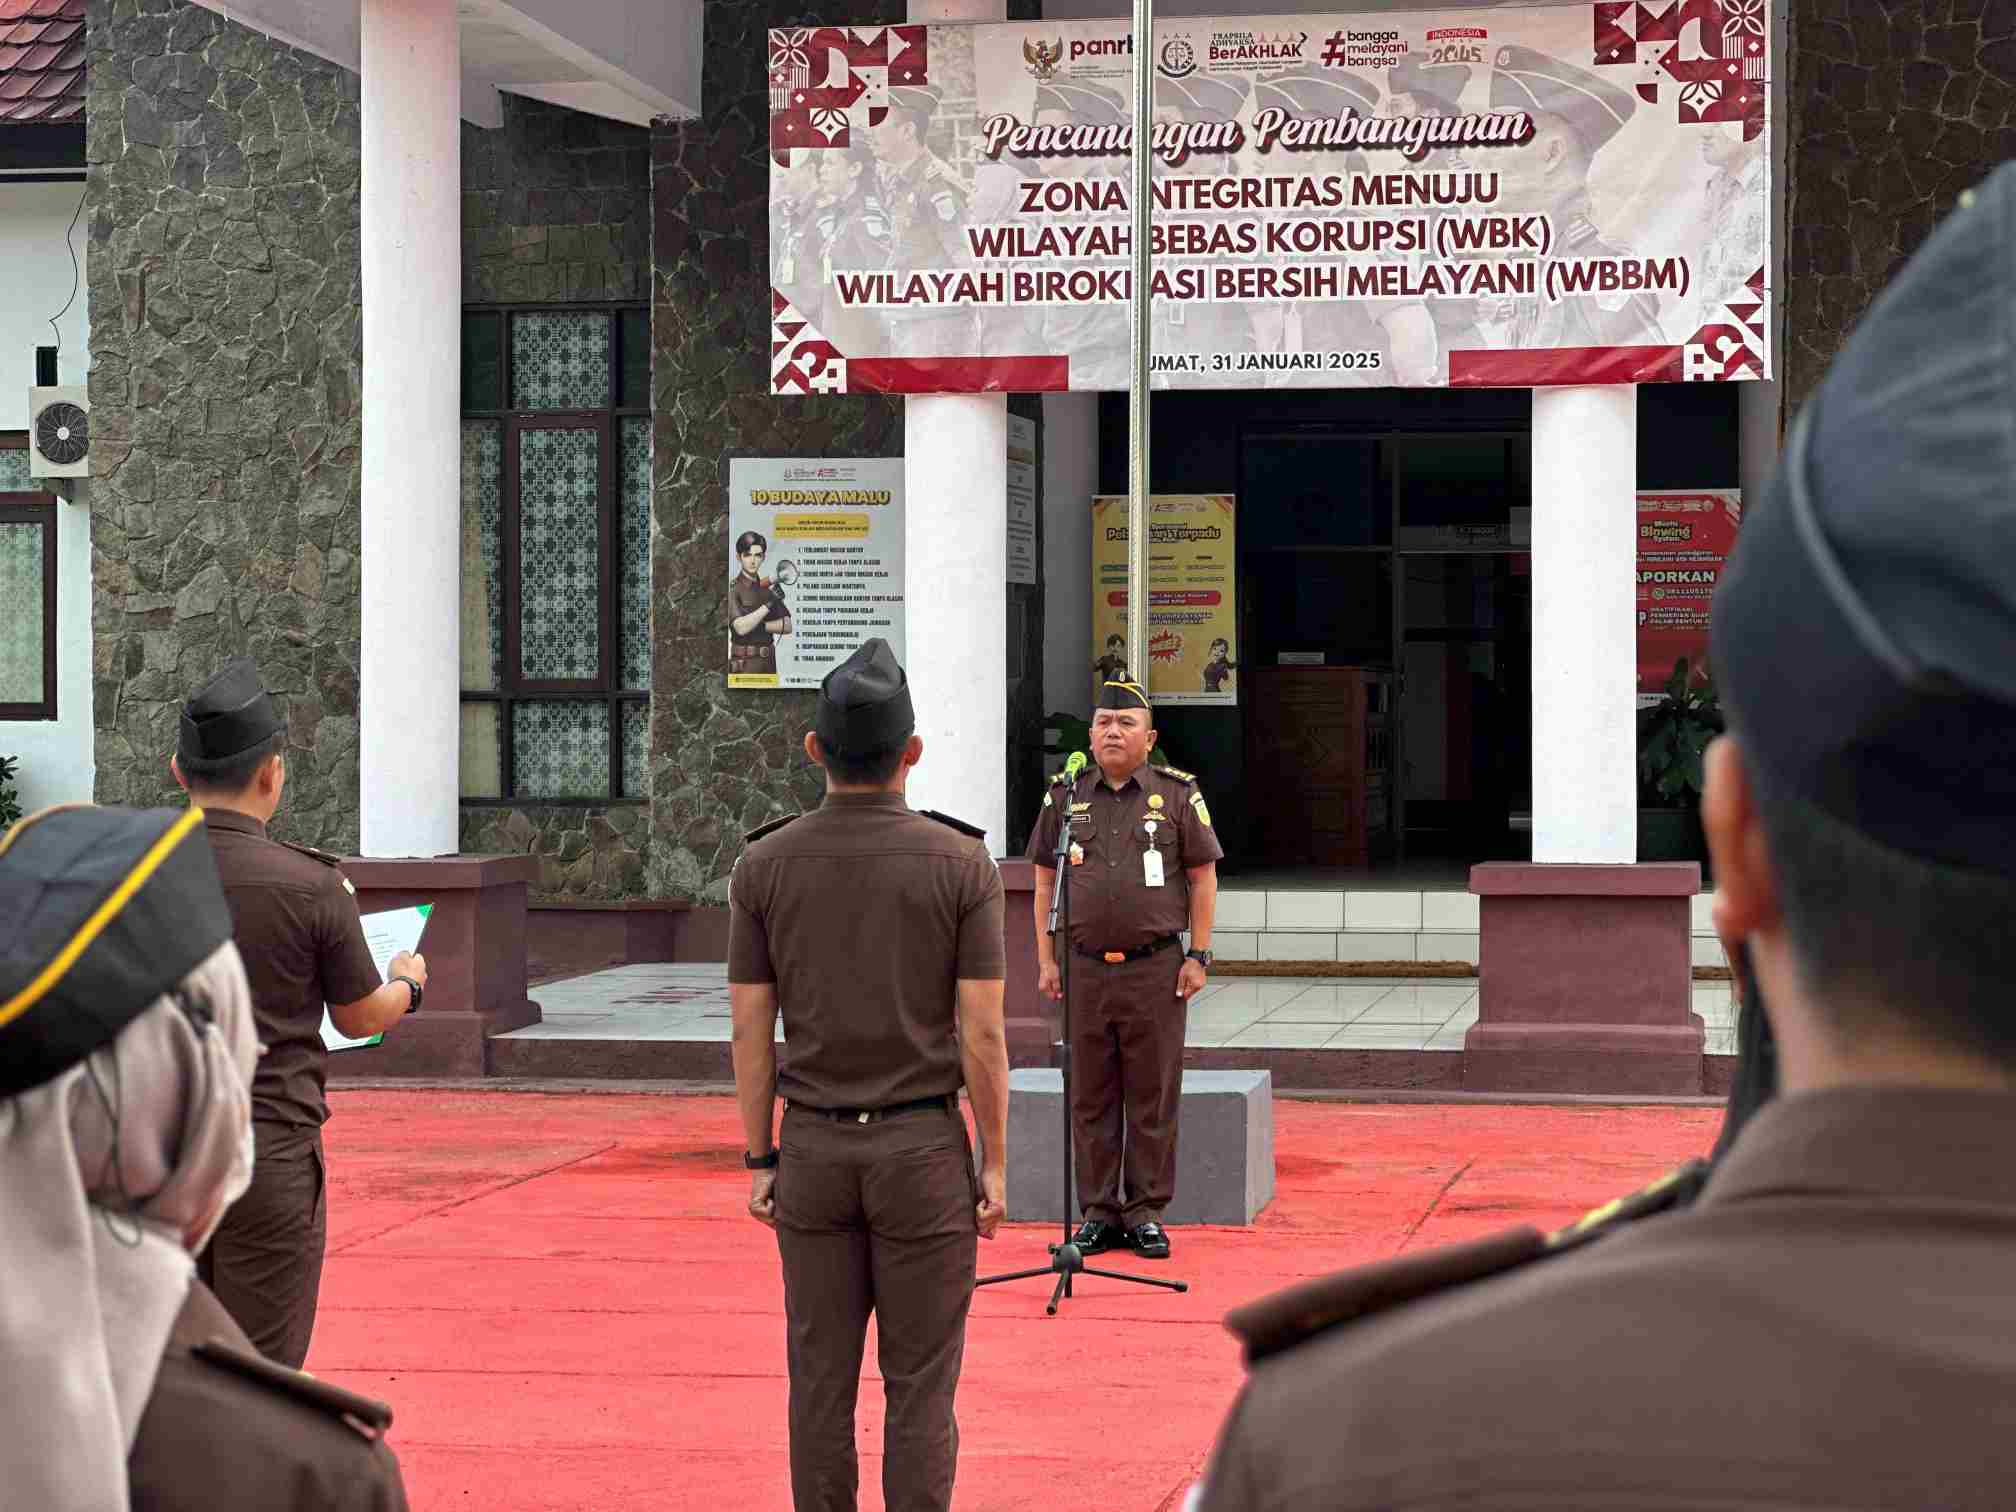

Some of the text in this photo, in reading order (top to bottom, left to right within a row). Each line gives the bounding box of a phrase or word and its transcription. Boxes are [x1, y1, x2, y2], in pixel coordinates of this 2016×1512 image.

[1347, 30, 1398, 43] bangga
[1209, 43, 1302, 60] BerAKHLAK
[1346, 42, 1408, 55] melayani
[1346, 55, 1397, 68] bangsa
[1251, 106, 1535, 161] Pembangunan
[1020, 173, 1499, 212] ZONA NTEGRITAS MENUJU
[968, 215, 1551, 258] WILAYAH BEBAS KORUPSI (WBK)
[837, 256, 1690, 303] WILAYAH BIROKASI BERSIH MELAYANI (WBBM)
[1149, 352, 1381, 374] UMAT, 31 JANUARI 2025
[751, 489, 891, 505] 10 BUDAYA MALU
[1636, 571, 1715, 583] APORKAN
